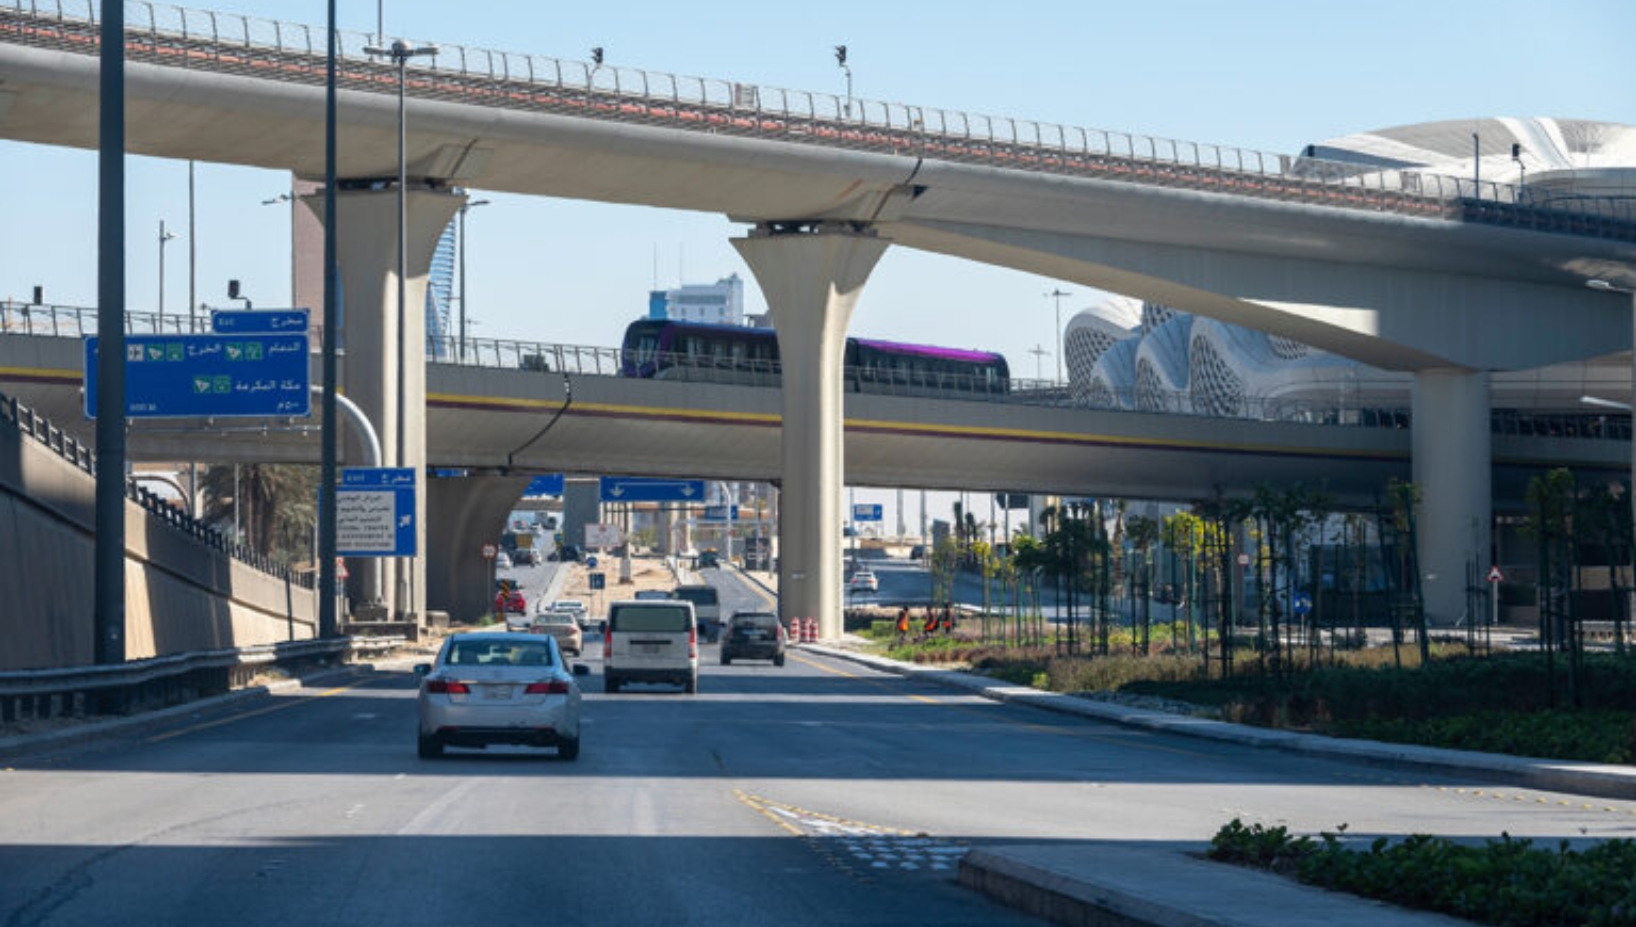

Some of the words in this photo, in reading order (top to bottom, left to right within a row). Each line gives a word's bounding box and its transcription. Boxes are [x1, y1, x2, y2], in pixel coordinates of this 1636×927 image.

[271, 316, 304, 328] مخرج
[187, 343, 222, 357] الخرج
[235, 379, 276, 394] المكرمة
[280, 379, 301, 391] مكة
